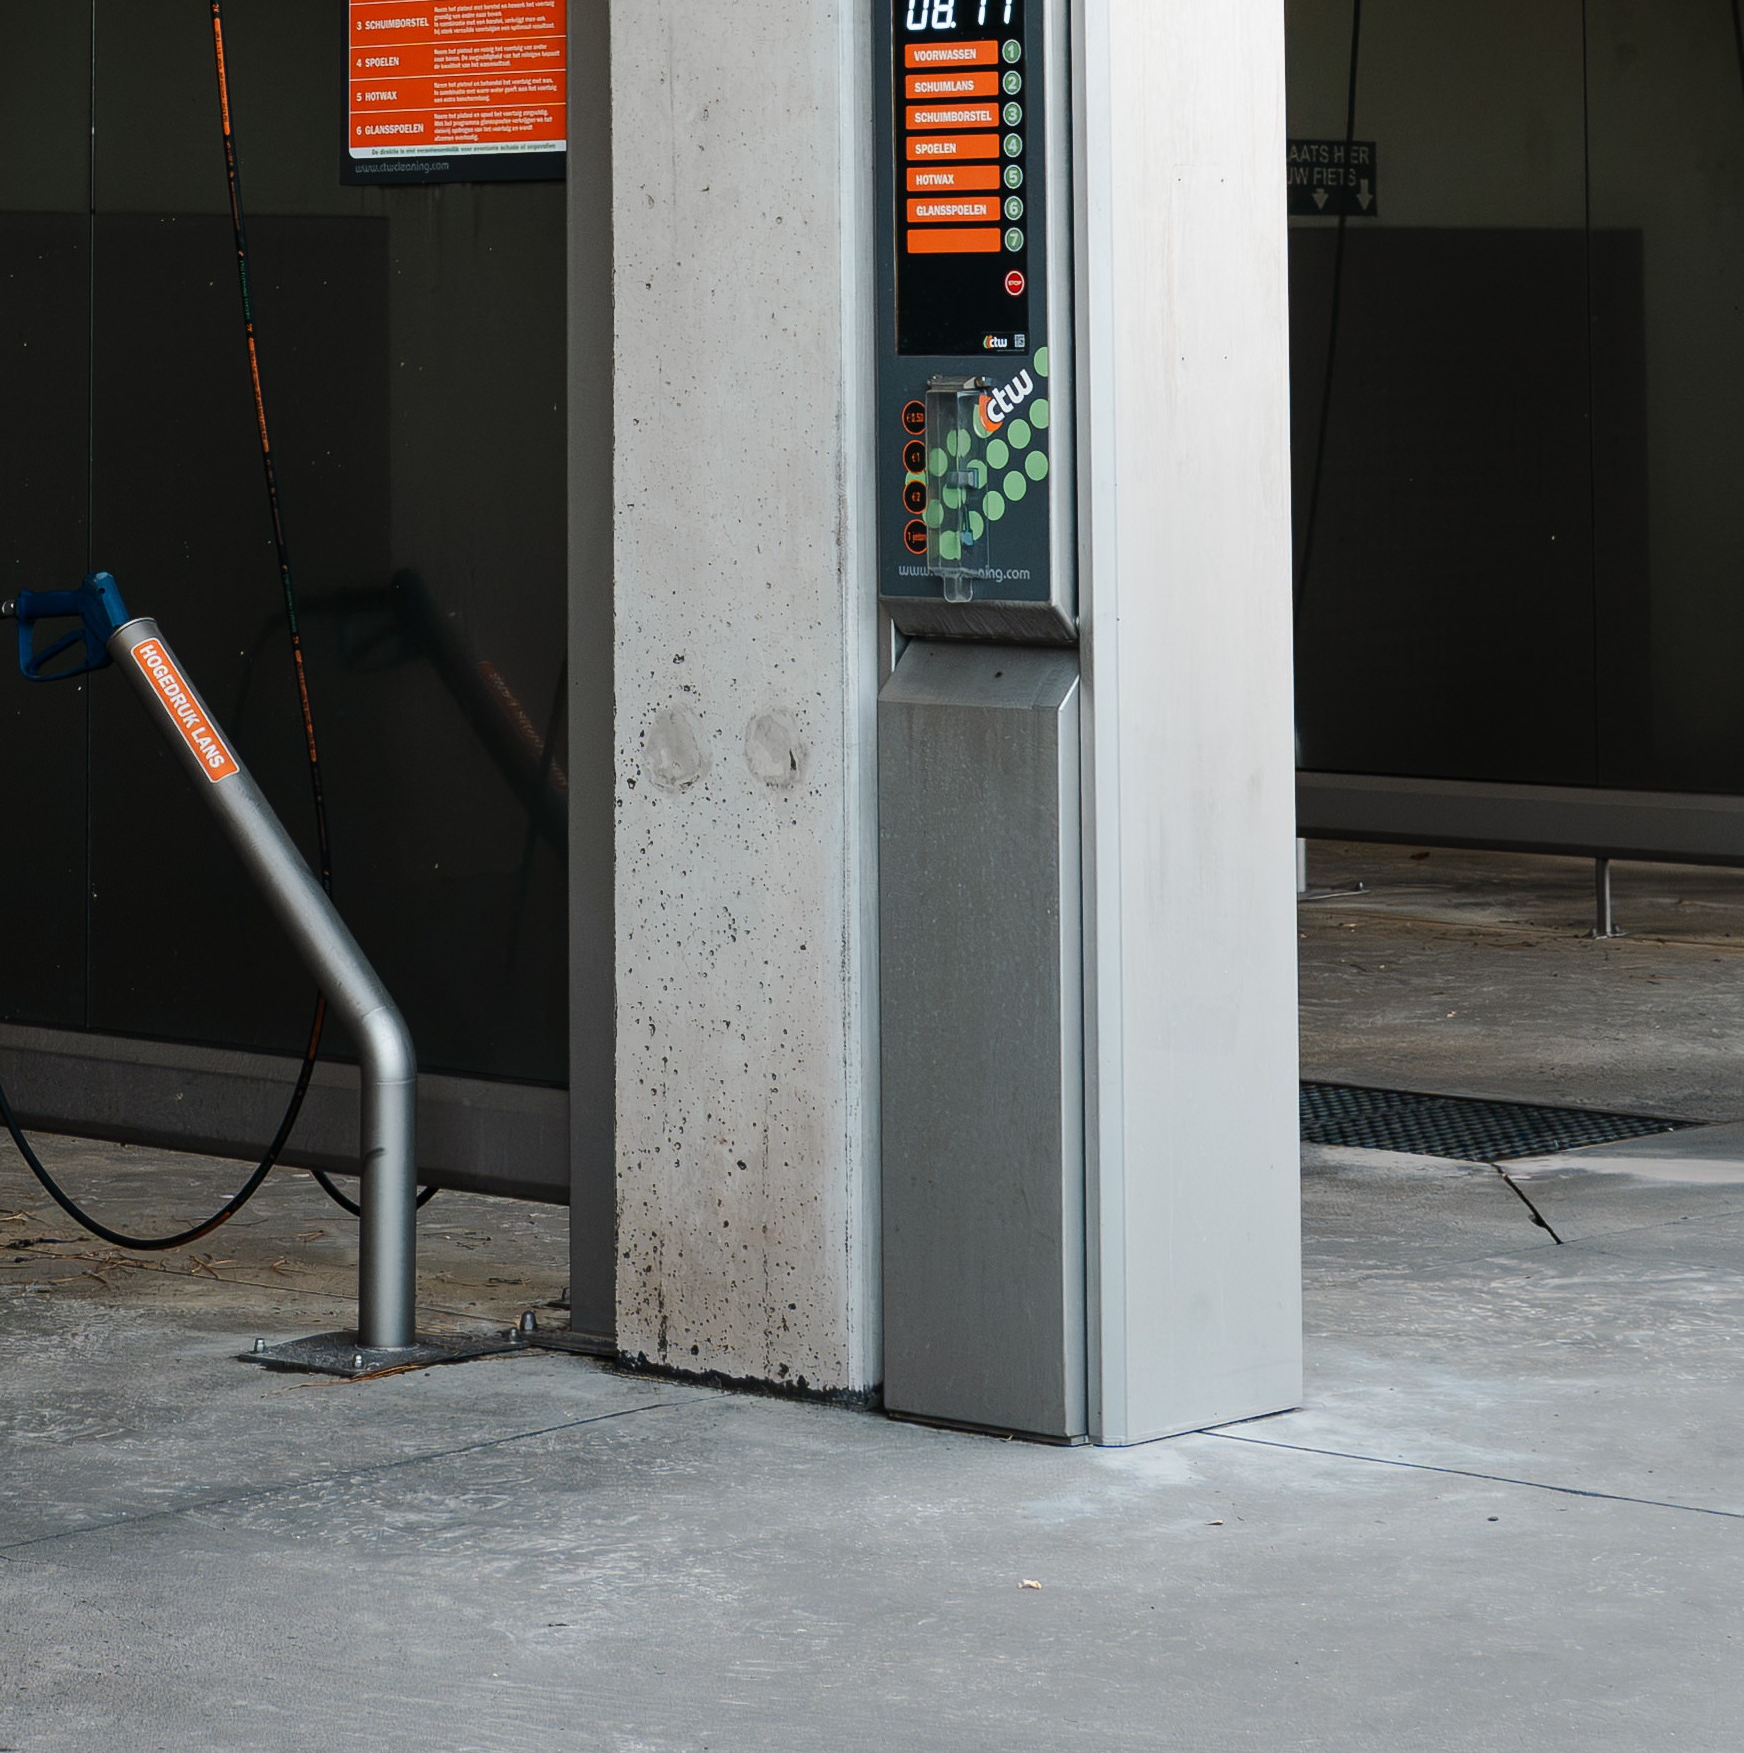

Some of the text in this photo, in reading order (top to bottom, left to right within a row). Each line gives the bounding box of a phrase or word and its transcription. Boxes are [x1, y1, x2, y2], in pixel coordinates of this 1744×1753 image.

[357, 21, 362, 30] 3
[365, 18, 429, 30] SCHUIMBORSTEL
[914, 45, 1015, 61] VOORWASSEN 1
[356, 57, 399, 67] 4 SPOELEN
[914, 76, 1017, 93] SCHUIMLANS 2
[356, 91, 397, 101] 5 HOTWAX
[915, 108, 1018, 123] SCHUIMBORSTEL 3
[356, 126, 362, 135] 6
[365, 123, 424, 135] GLANSSPOELEN
[915, 139, 1017, 154] SPOELEN 4
[1287, 144, 1370, 164] AATS HER
[916, 170, 1018, 185] HOTWAX 5
[916, 201, 1018, 216] GLANSSPOELEN 6
[1010, 233, 1018, 246] 7
[989, 336, 1007, 348] ctw
[987, 368, 1034, 423] ctw
[140, 644, 225, 769] HOGEDRUK LANS
